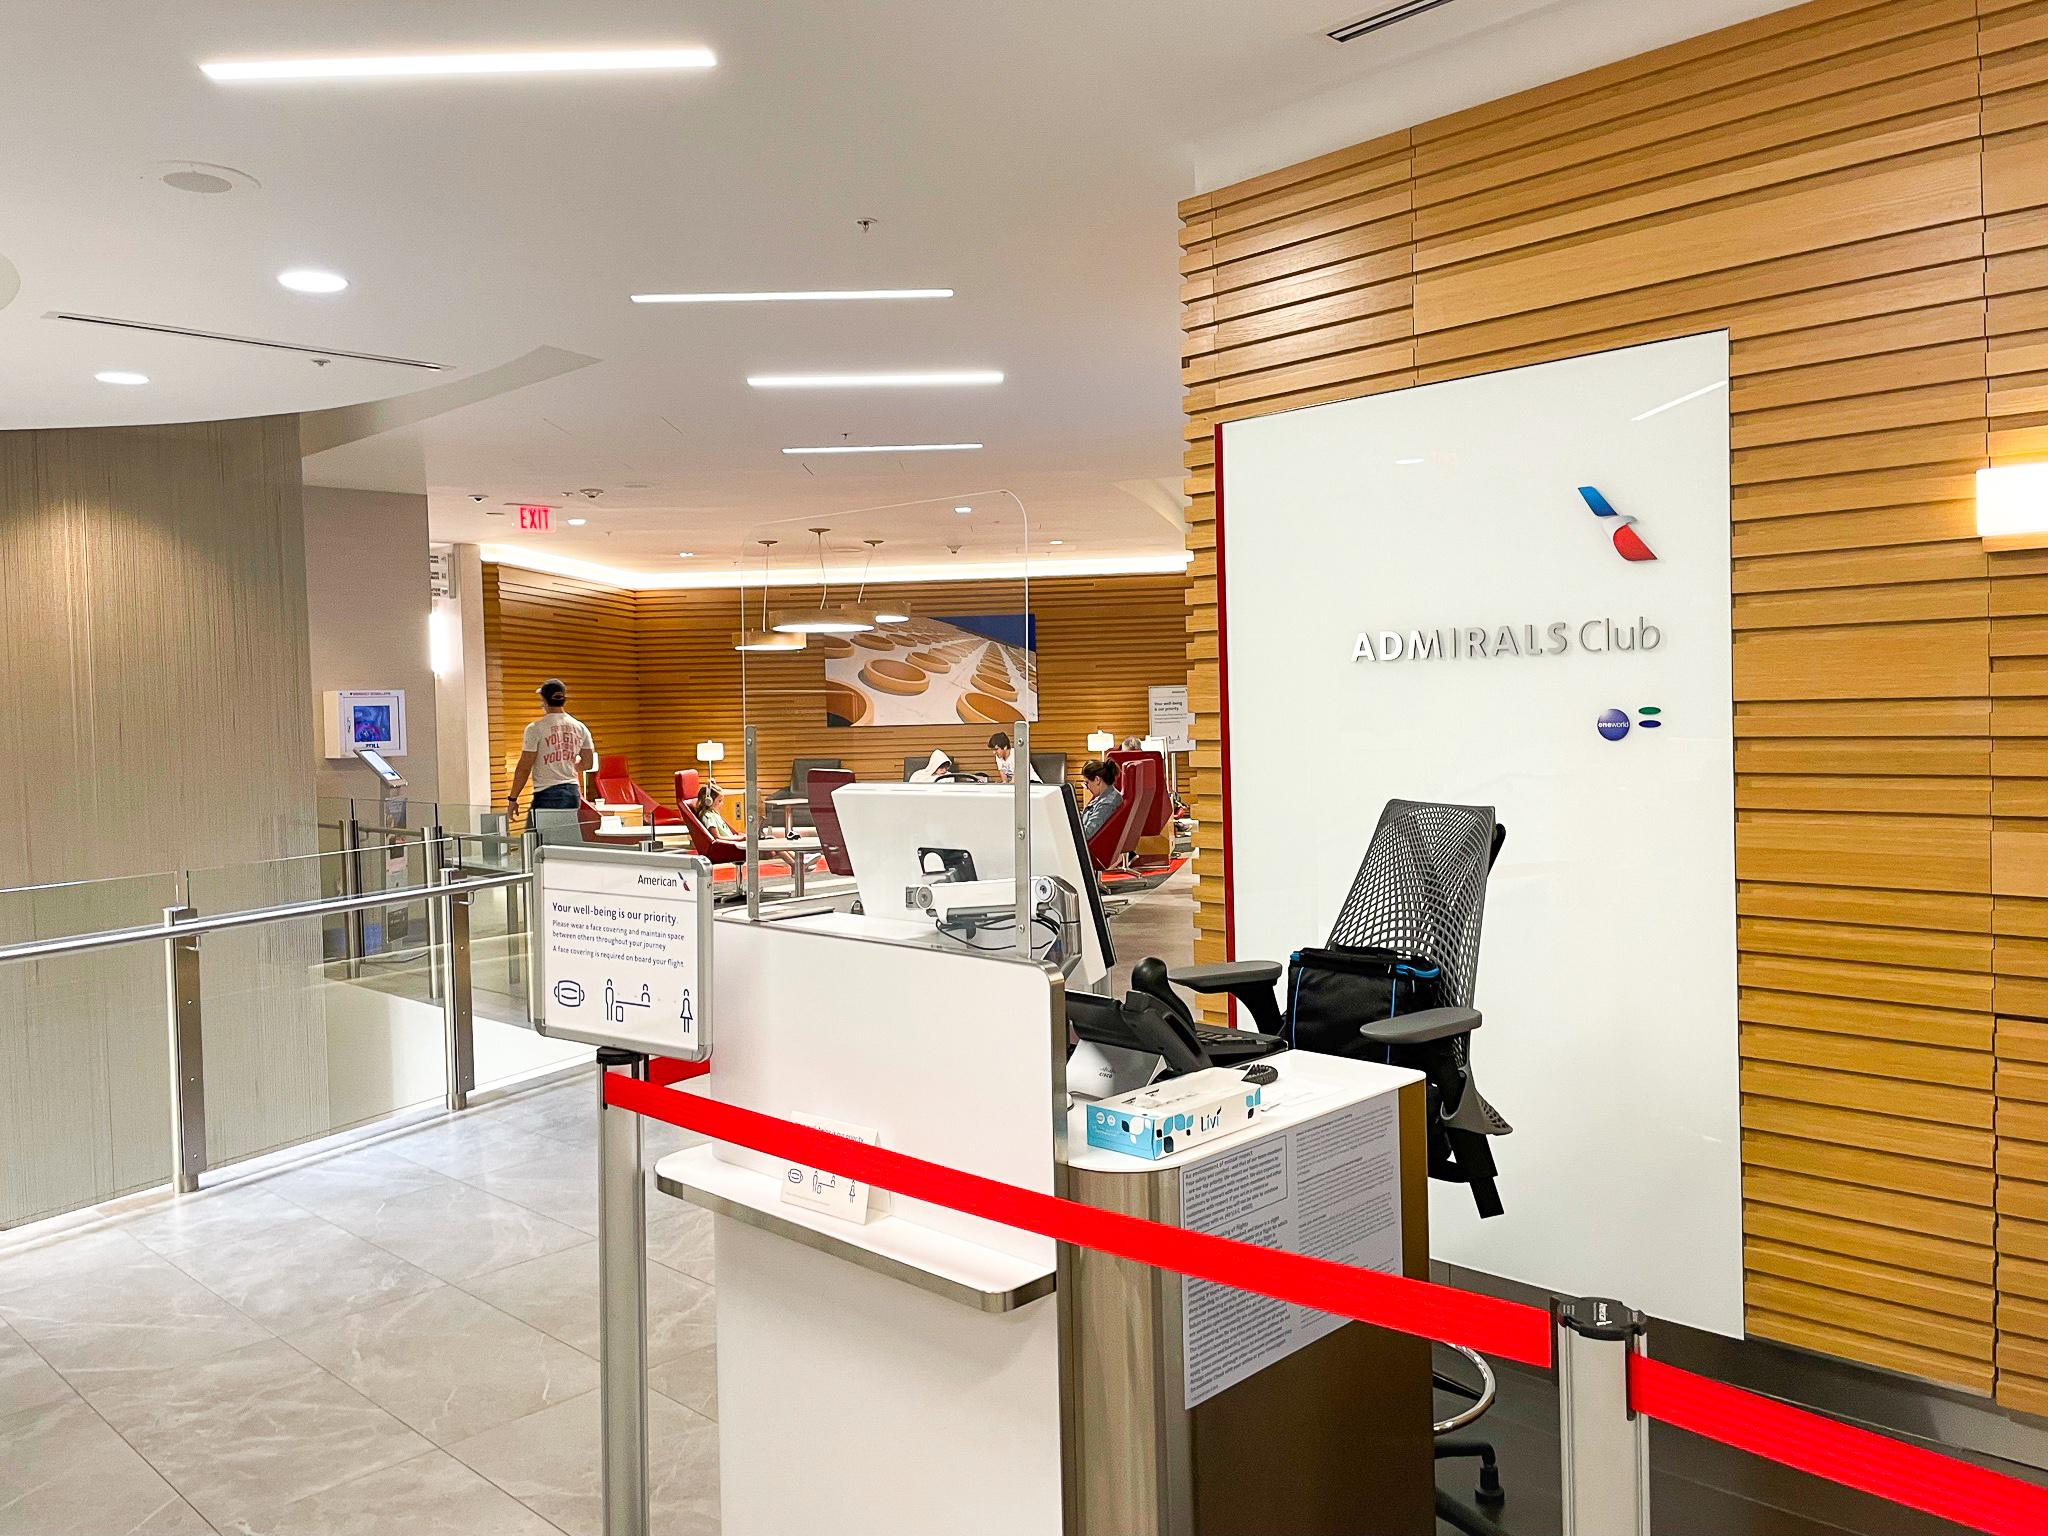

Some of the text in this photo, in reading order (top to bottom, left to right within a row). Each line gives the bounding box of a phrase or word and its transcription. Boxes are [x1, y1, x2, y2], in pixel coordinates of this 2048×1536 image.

[520, 507, 549, 530] EXIT
[1351, 616, 1661, 662] ADMIRALS Club
[637, 874, 678, 888] American
[552, 902, 679, 926] Your well-being is our priority.
[552, 920, 569, 928] Please
[603, 926, 627, 936] covering
[641, 930, 666, 939] maintain
[667, 933, 684, 941] space
[552, 931, 576, 939] between
[577, 934, 595, 942] others
[596, 936, 628, 946] throughout
[558, 946, 569, 954] face
[570, 948, 594, 958] covering
[600, 952, 625, 962] required
[634, 955, 651, 963] board
[652, 958, 667, 967] your
